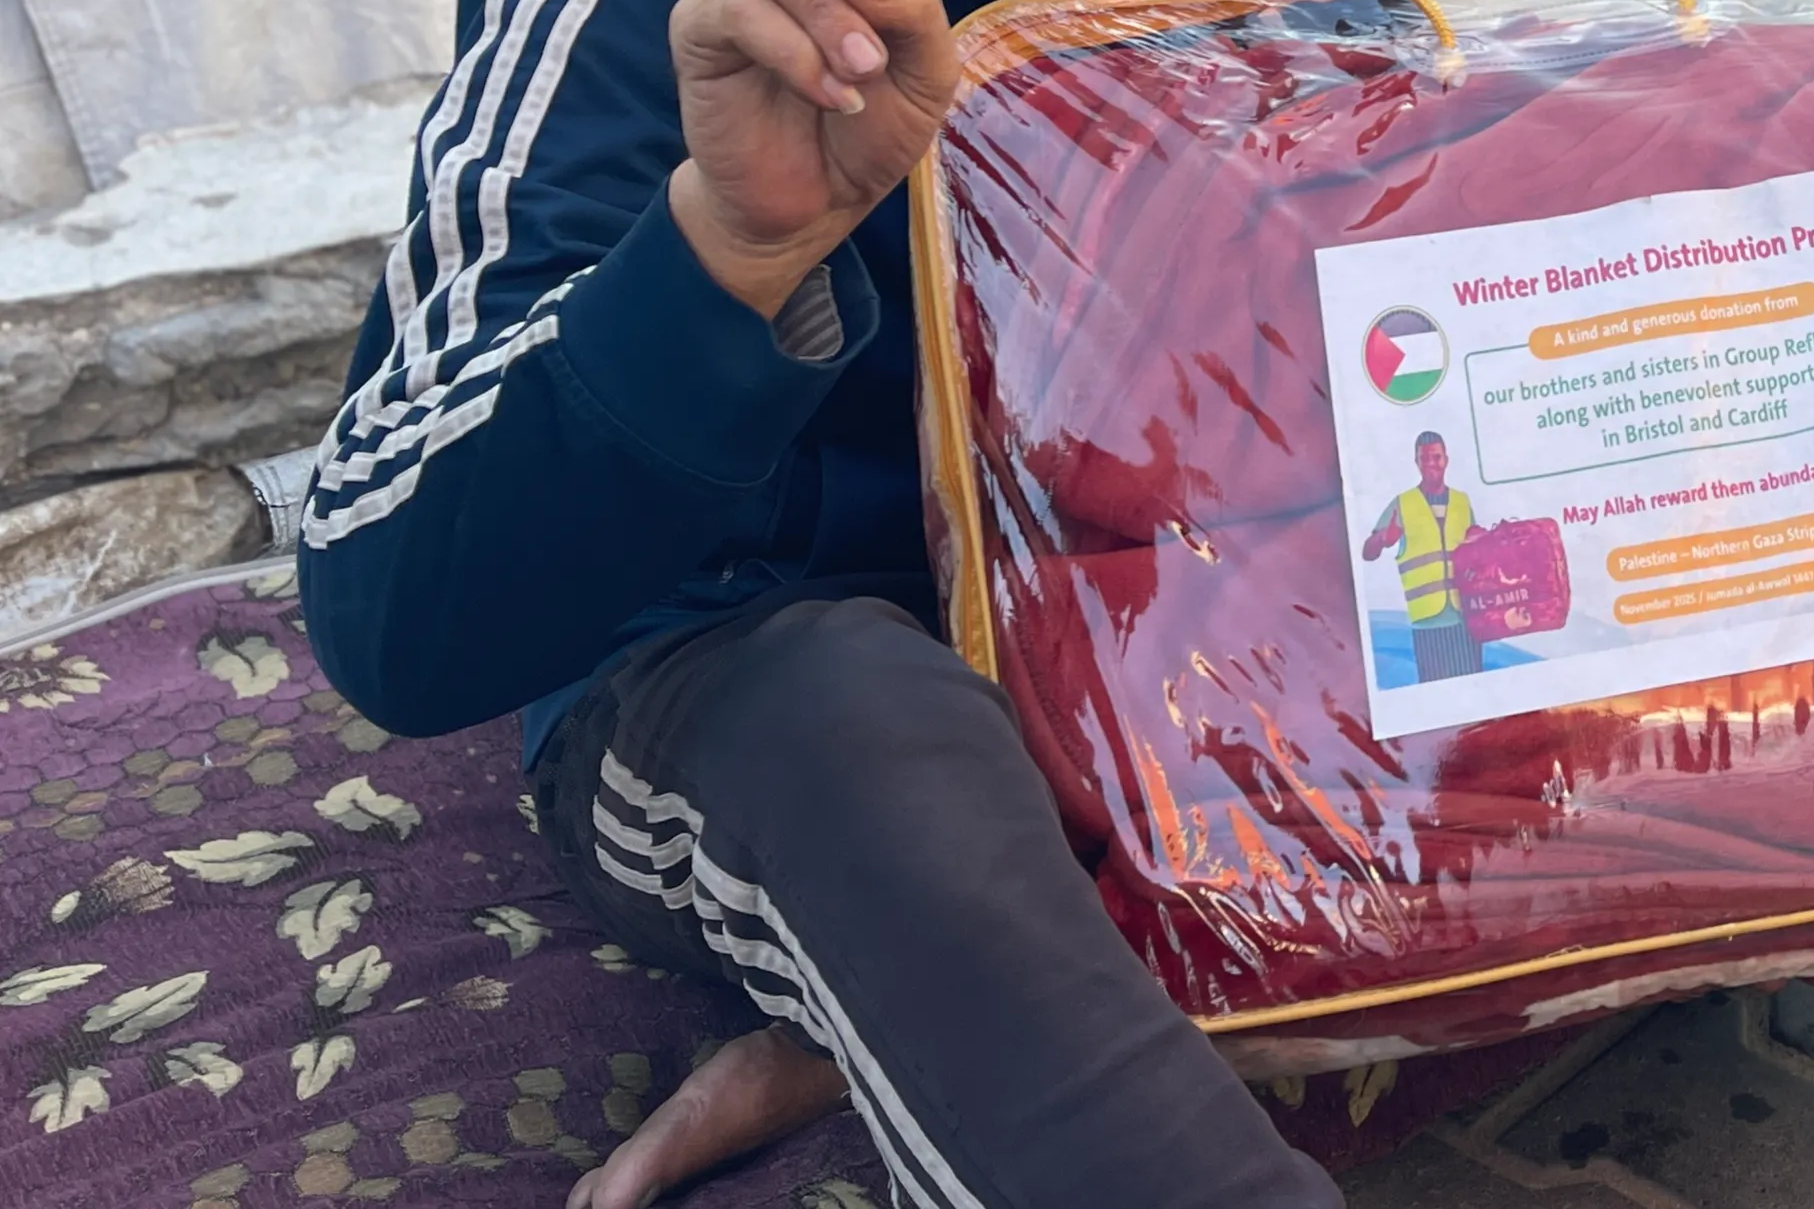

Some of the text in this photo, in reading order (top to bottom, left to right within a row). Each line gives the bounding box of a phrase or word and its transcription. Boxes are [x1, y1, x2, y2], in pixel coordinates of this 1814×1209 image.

[1453, 275, 1539, 306] Winter
[1545, 253, 1639, 293] Blanket
[1643, 236, 1787, 273] Distribution
[1554, 294, 1799, 346] A kind and generous donation from
[1484, 388, 1515, 405] our
[1520, 375, 1597, 400] brothers
[1602, 361, 1636, 385] and
[1641, 354, 1699, 378] sisters
[1702, 350, 1720, 369] in
[1725, 345, 1780, 366] Group
[1537, 405, 1589, 429] along
[1593, 396, 1636, 418] with
[1639, 378, 1742, 409] benevolent
[1602, 399, 1788, 448] in Bristol and Cardiff
[1563, 505, 1598, 525] May
[1603, 494, 1646, 517] Allah
[1650, 483, 1707, 509] reward
[1711, 480, 1755, 499] them
[1619, 551, 1678, 571] Palestine
[1692, 539, 1750, 560] Northern
[1753, 533, 1785, 549] Gaza
[1470, 588, 1529, 609] AL-AMIR
[1620, 596, 1672, 616] November
[1673, 592, 1697, 607] 2025
